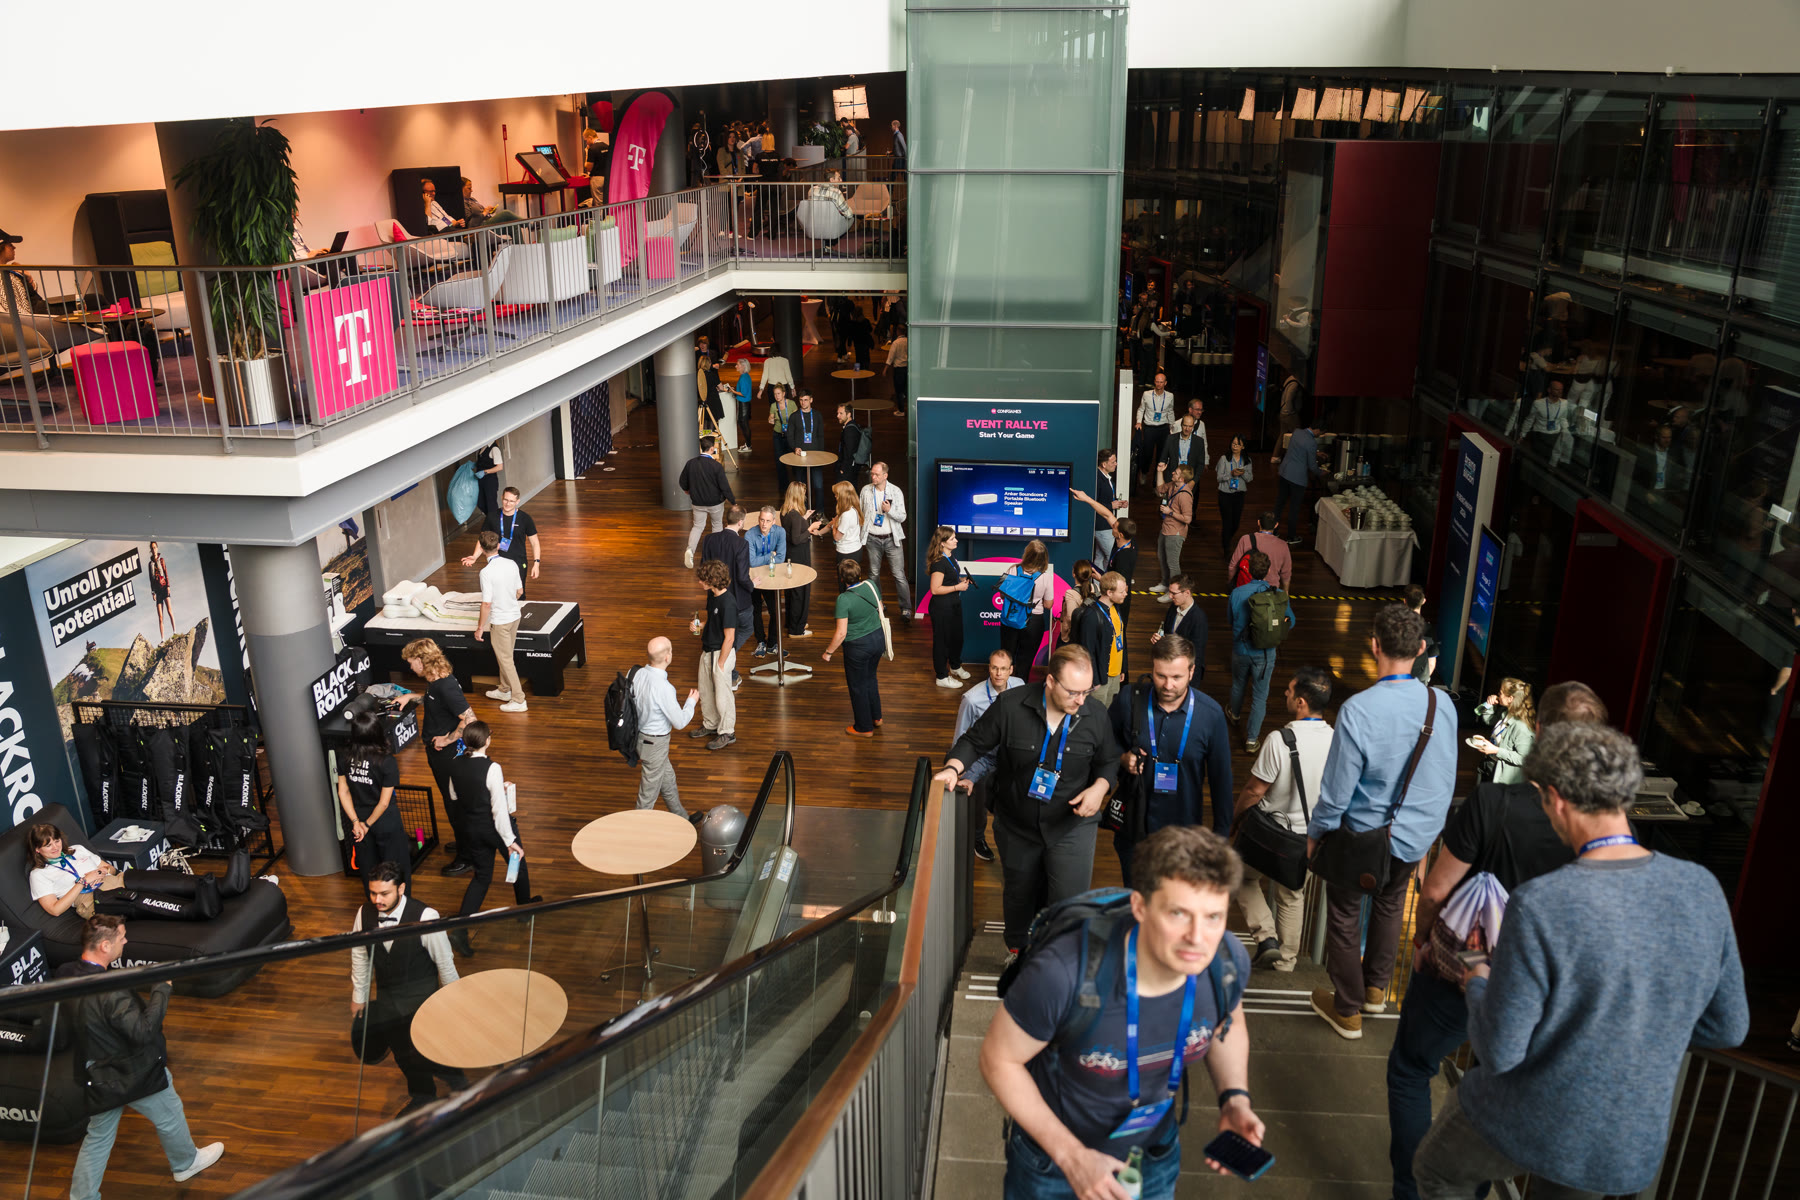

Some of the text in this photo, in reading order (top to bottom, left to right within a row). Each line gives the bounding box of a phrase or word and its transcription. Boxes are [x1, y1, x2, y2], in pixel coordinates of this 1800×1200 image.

[966, 419, 1048, 430] EVENT RALLYE
[44, 553, 139, 610] Unroll your
[52, 582, 135, 648] potential!
[313, 657, 354, 703] BLACK
[11, 946, 42, 979] BLA
